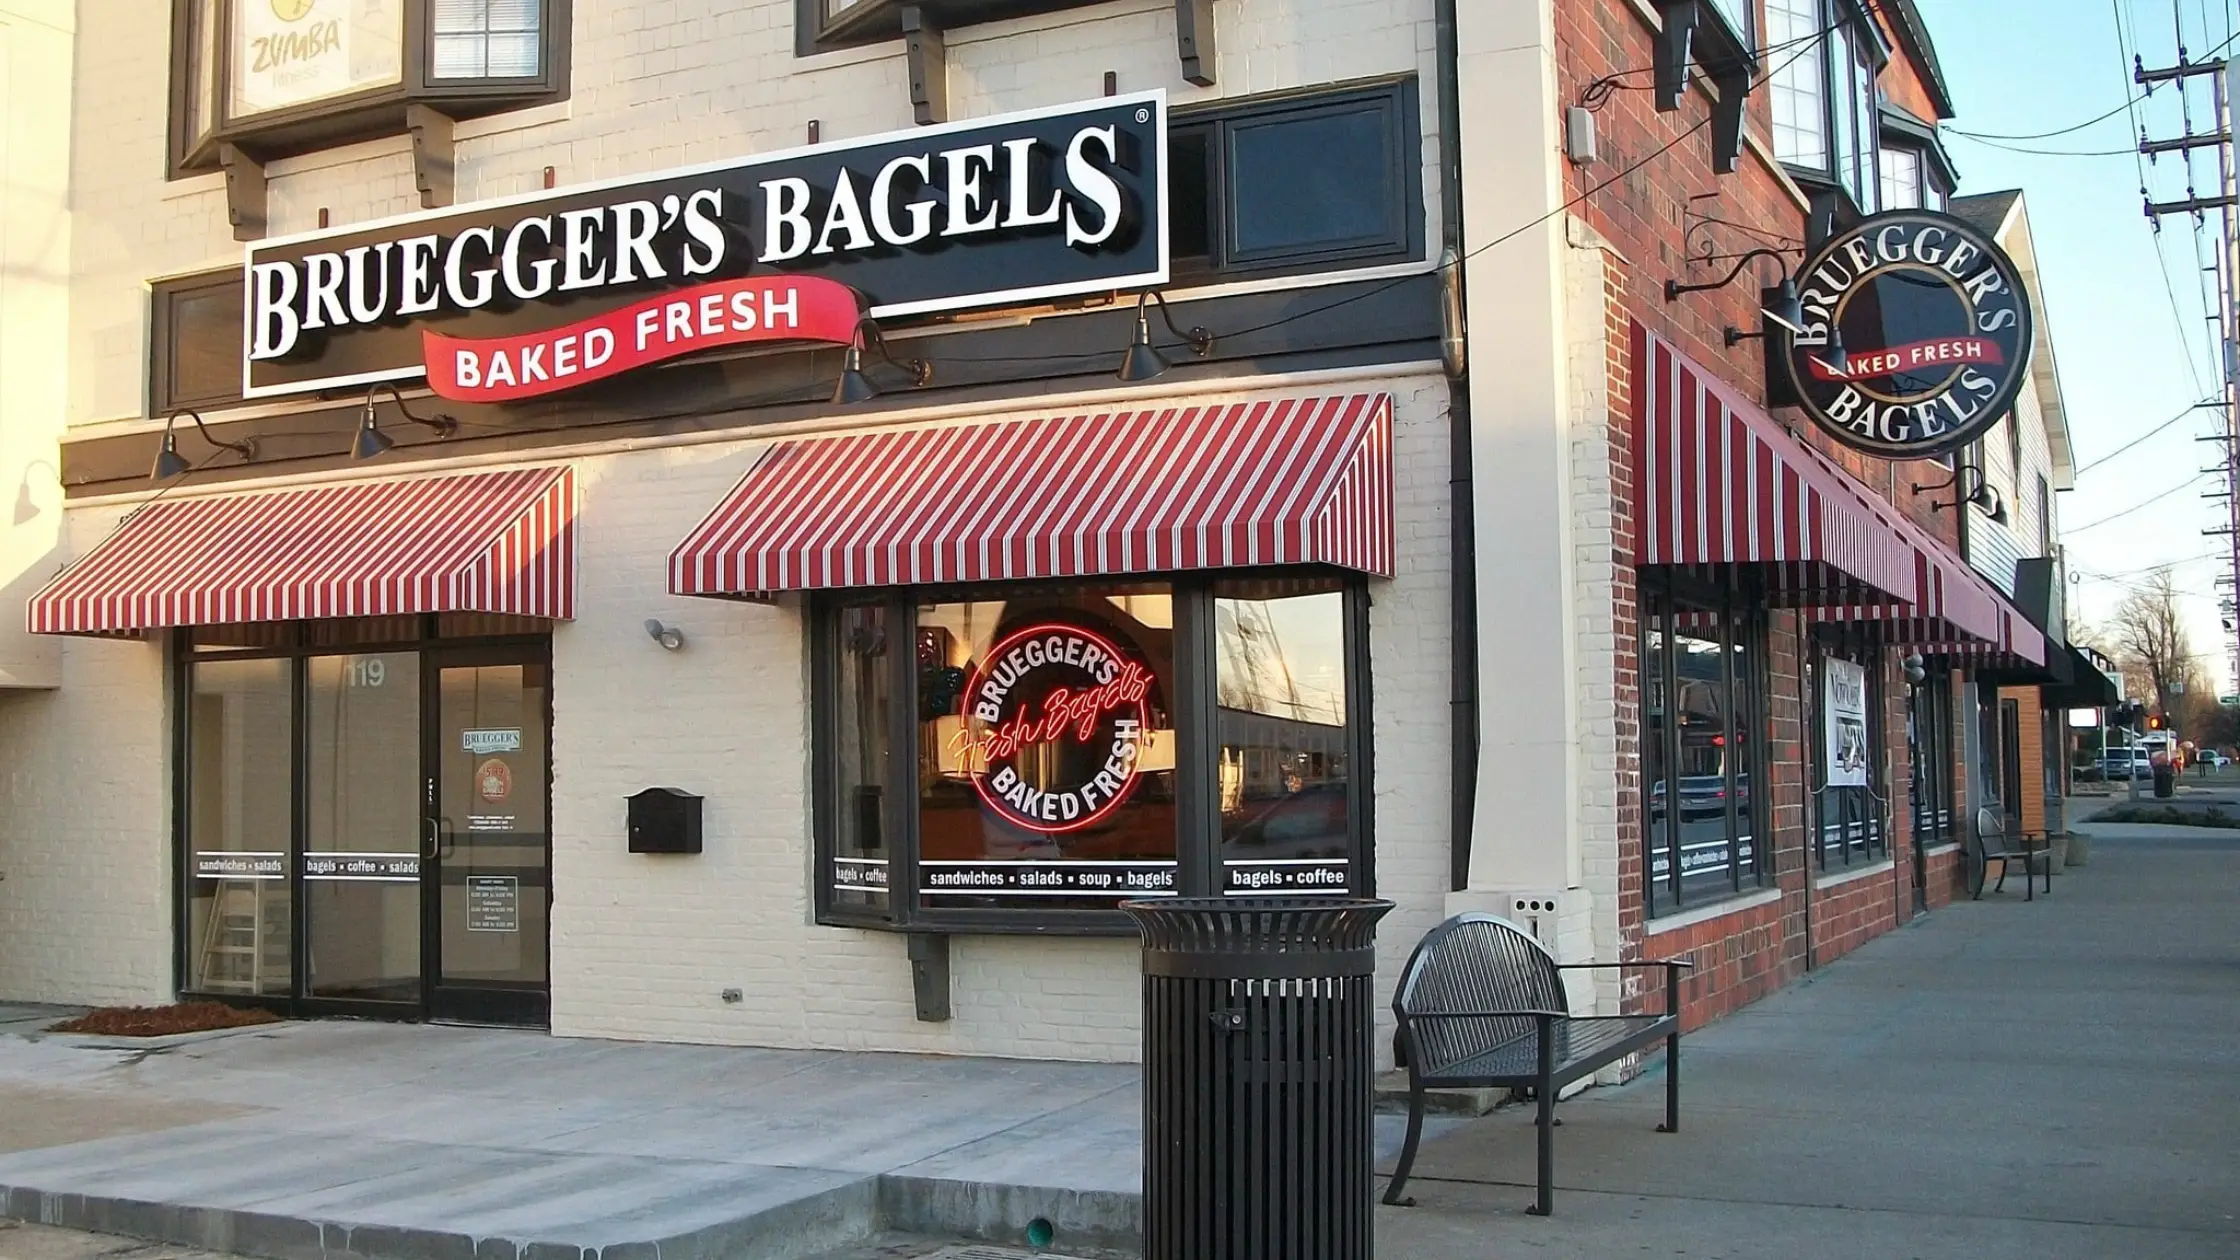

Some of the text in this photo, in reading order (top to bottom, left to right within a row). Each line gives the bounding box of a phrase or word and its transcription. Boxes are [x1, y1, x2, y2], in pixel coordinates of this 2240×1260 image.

[251, 20, 341, 73] ZUMBA
[249, 123, 1122, 361] BRUEGGER'S BAGELS
[1793, 225, 2017, 348] BRUEGGER'S
[455, 287, 799, 390] BAKED FRESH
[1827, 341, 1982, 376] KED FRESH
[1824, 366, 1996, 442] BAGELS
[344, 658, 385, 687] 119
[975, 636, 1119, 723] BRUEGGER'S
[947, 662, 1154, 777] Fresh Bagels
[991, 719, 1140, 820] BAKED FRESH
[199, 858, 282, 872] sandwiches salads
[307, 859, 420, 874] bagels coffee salads
[835, 866, 887, 883] bagels coffee
[930, 871, 1173, 888] sandwiches salads soup bagels
[1232, 869, 1345, 888] bagels coffee
